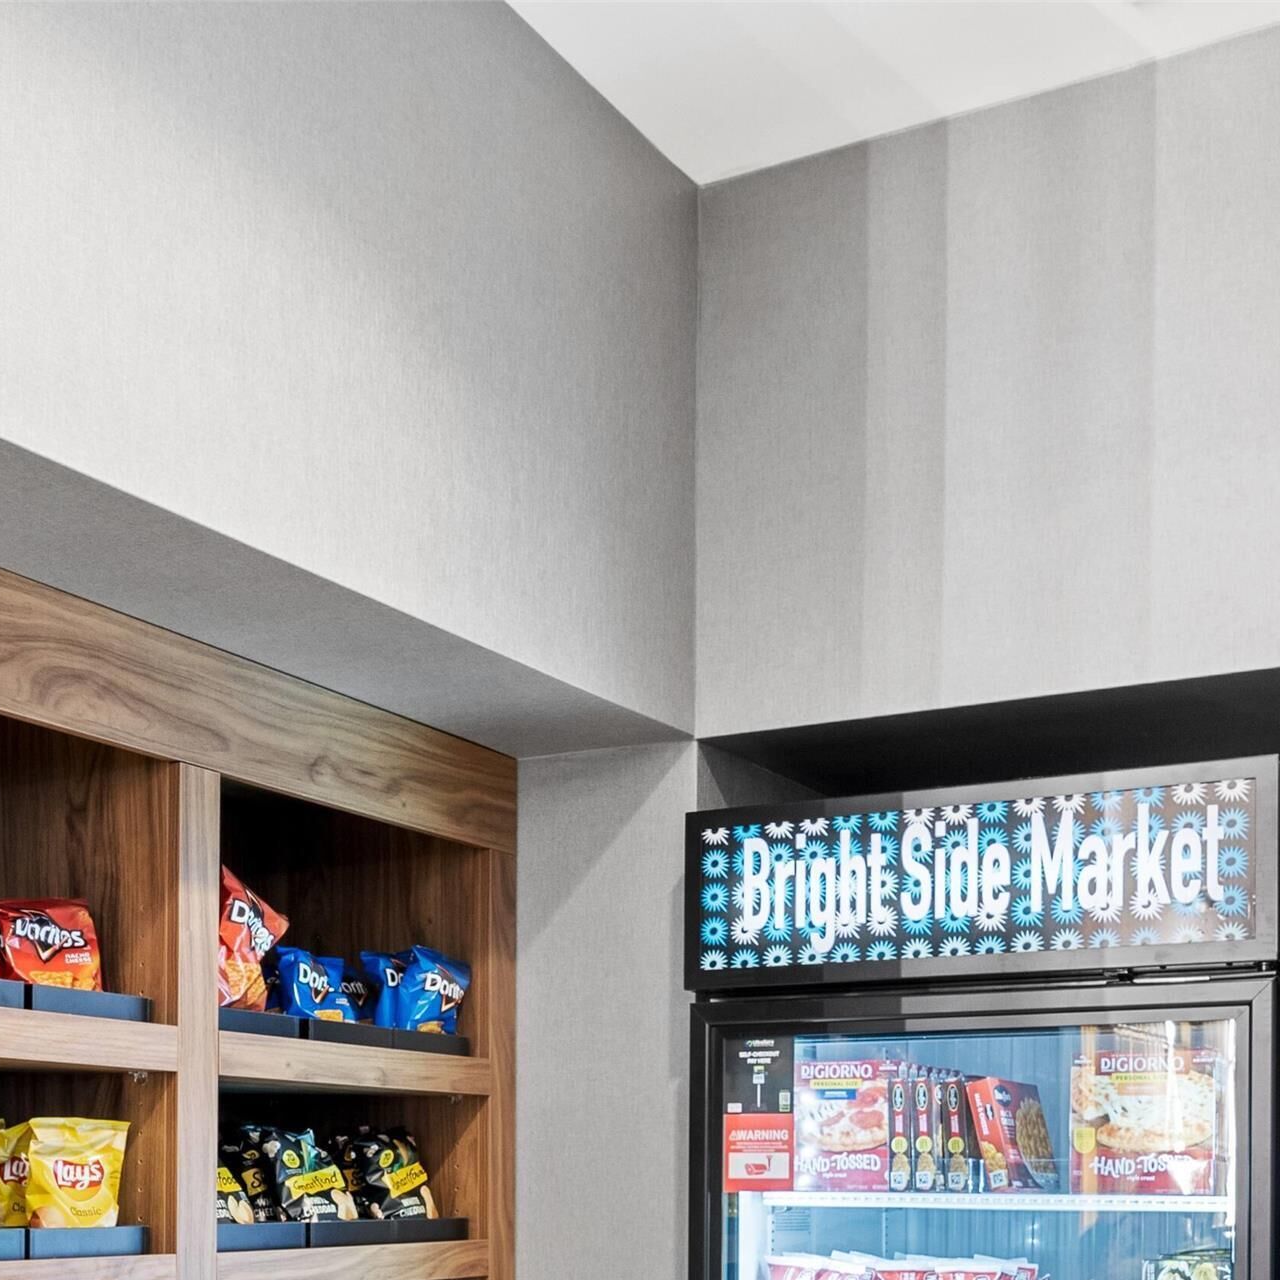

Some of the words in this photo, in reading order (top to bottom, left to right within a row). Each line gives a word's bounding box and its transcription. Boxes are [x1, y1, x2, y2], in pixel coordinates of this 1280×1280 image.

[743, 829, 886, 953] Bright
[901, 818, 1011, 921] Side
[1030, 803, 1224, 913] Market
[15, 917, 86, 948] Doritos
[801, 1063, 874, 1080] DIGIORNO
[738, 1129, 789, 1142] WARNING
[54, 1160, 104, 1190] Lay's
[795, 1152, 881, 1173] HAND-TOSSED
